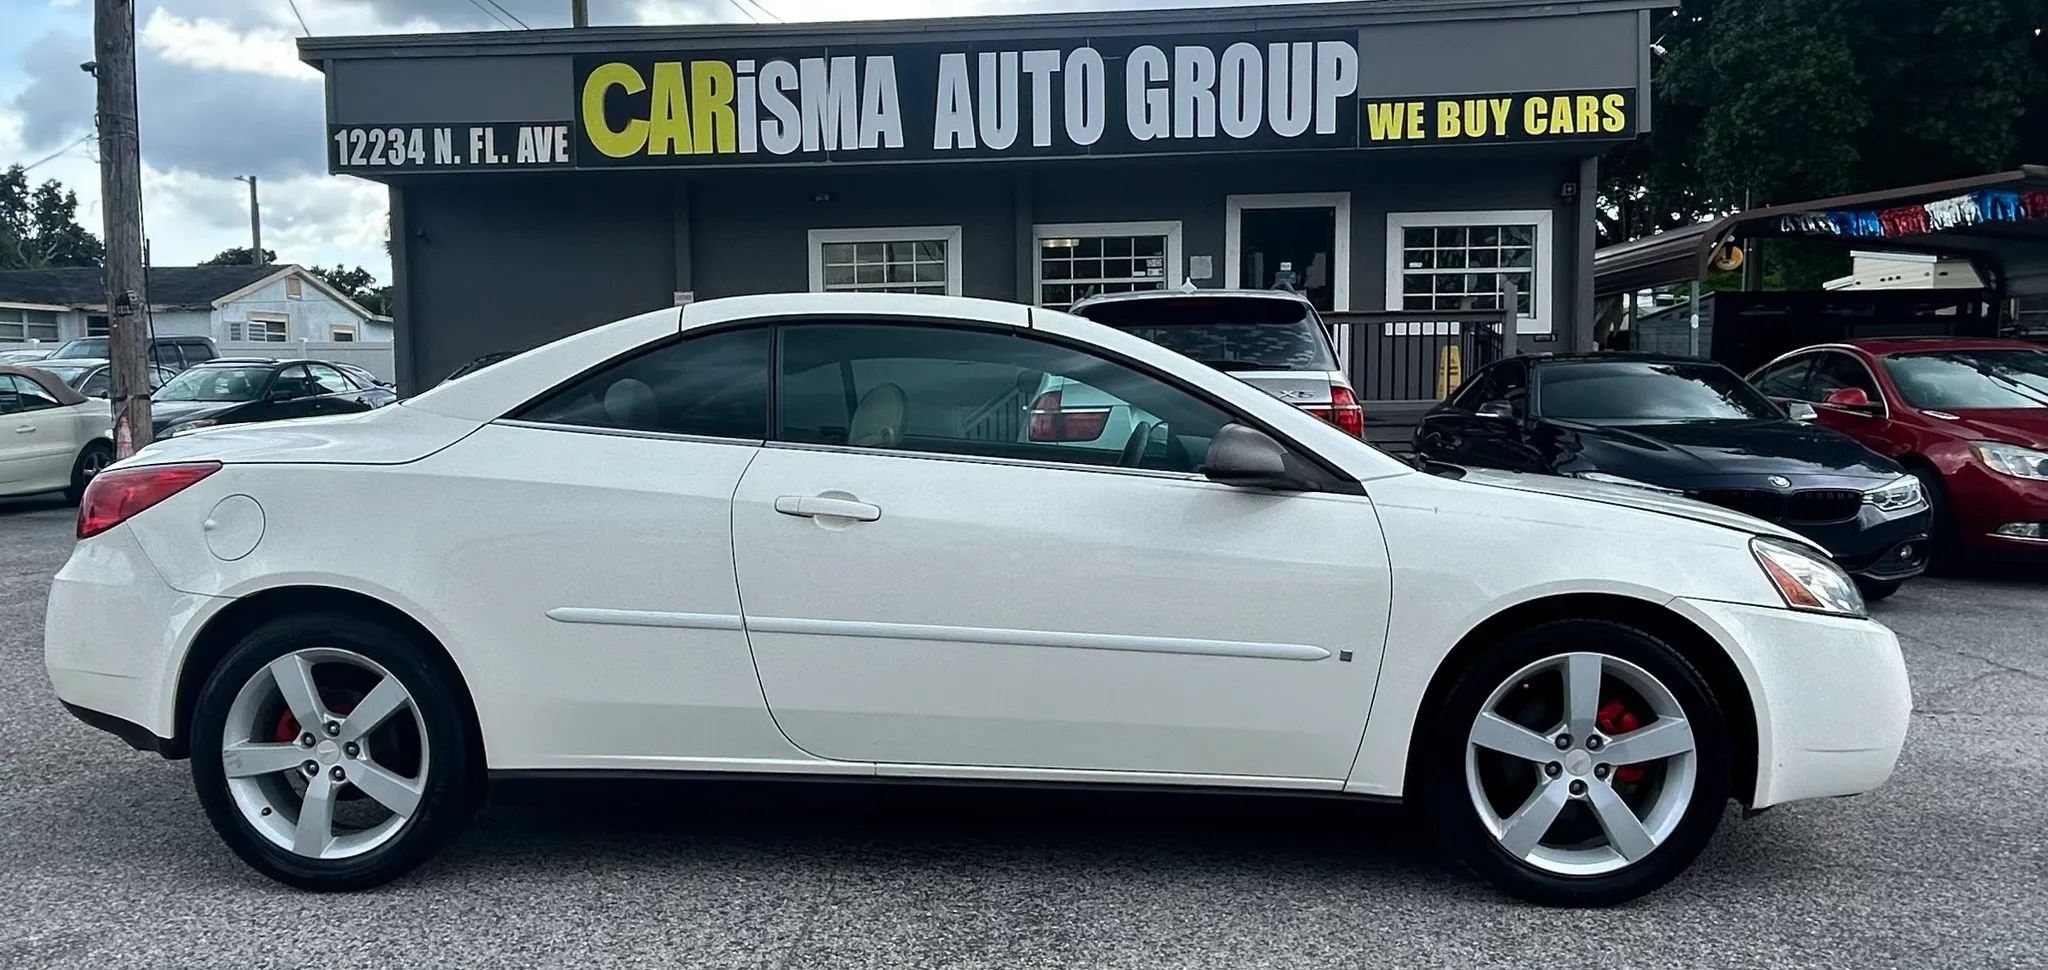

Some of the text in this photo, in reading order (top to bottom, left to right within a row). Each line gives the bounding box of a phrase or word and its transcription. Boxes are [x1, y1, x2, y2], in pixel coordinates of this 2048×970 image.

[583, 41, 1359, 157] CARiSMA AUTO GROUP
[1368, 94, 1625, 140] WE BUY CARS
[334, 126, 569, 166] 12234 N. FL. AVE
[1280, 390, 1314, 399] X5
